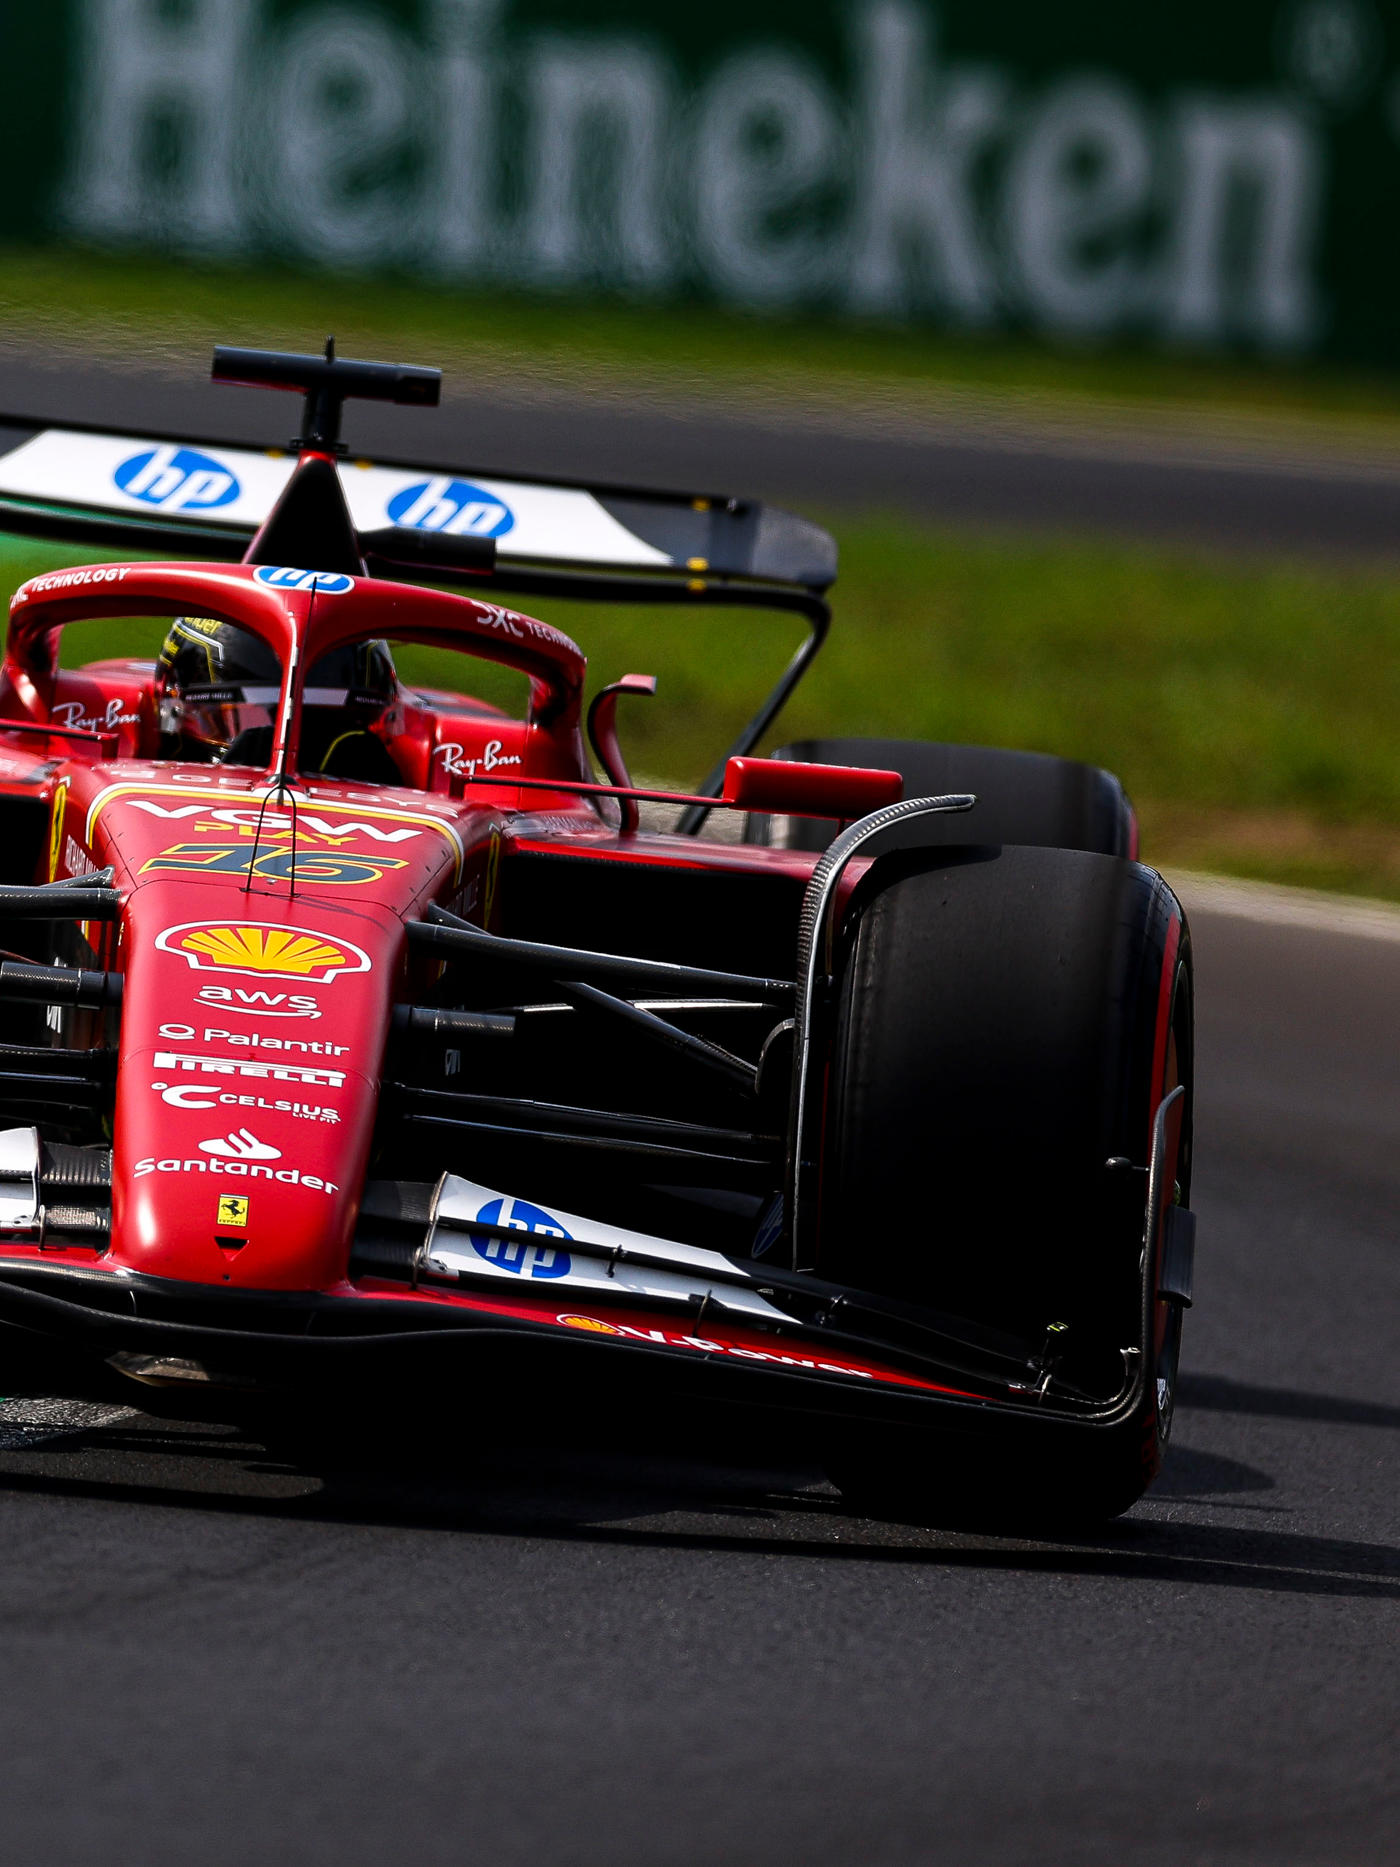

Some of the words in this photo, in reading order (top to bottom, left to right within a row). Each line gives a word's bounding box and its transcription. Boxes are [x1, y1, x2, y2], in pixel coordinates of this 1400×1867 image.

[66, 0, 1325, 350] Heineken
[122, 446, 238, 512] hp
[397, 476, 510, 538] hp
[32, 568, 131, 592] TECHNOLOGY
[52, 698, 141, 731] Ray-Ban
[432, 740, 521, 775] Ray-Ban
[125, 800, 423, 843] VGW
[194, 820, 358, 846] PLAY
[137, 842, 411, 885] 16
[198, 985, 318, 1010] aws
[203, 1028, 350, 1056] Palantir
[153, 1052, 347, 1088] PIRELLI
[219, 1093, 340, 1120] CELSIUS
[133, 1157, 339, 1195] Santander
[485, 1198, 566, 1279] hp
[617, 1325, 872, 1378] V-Power
